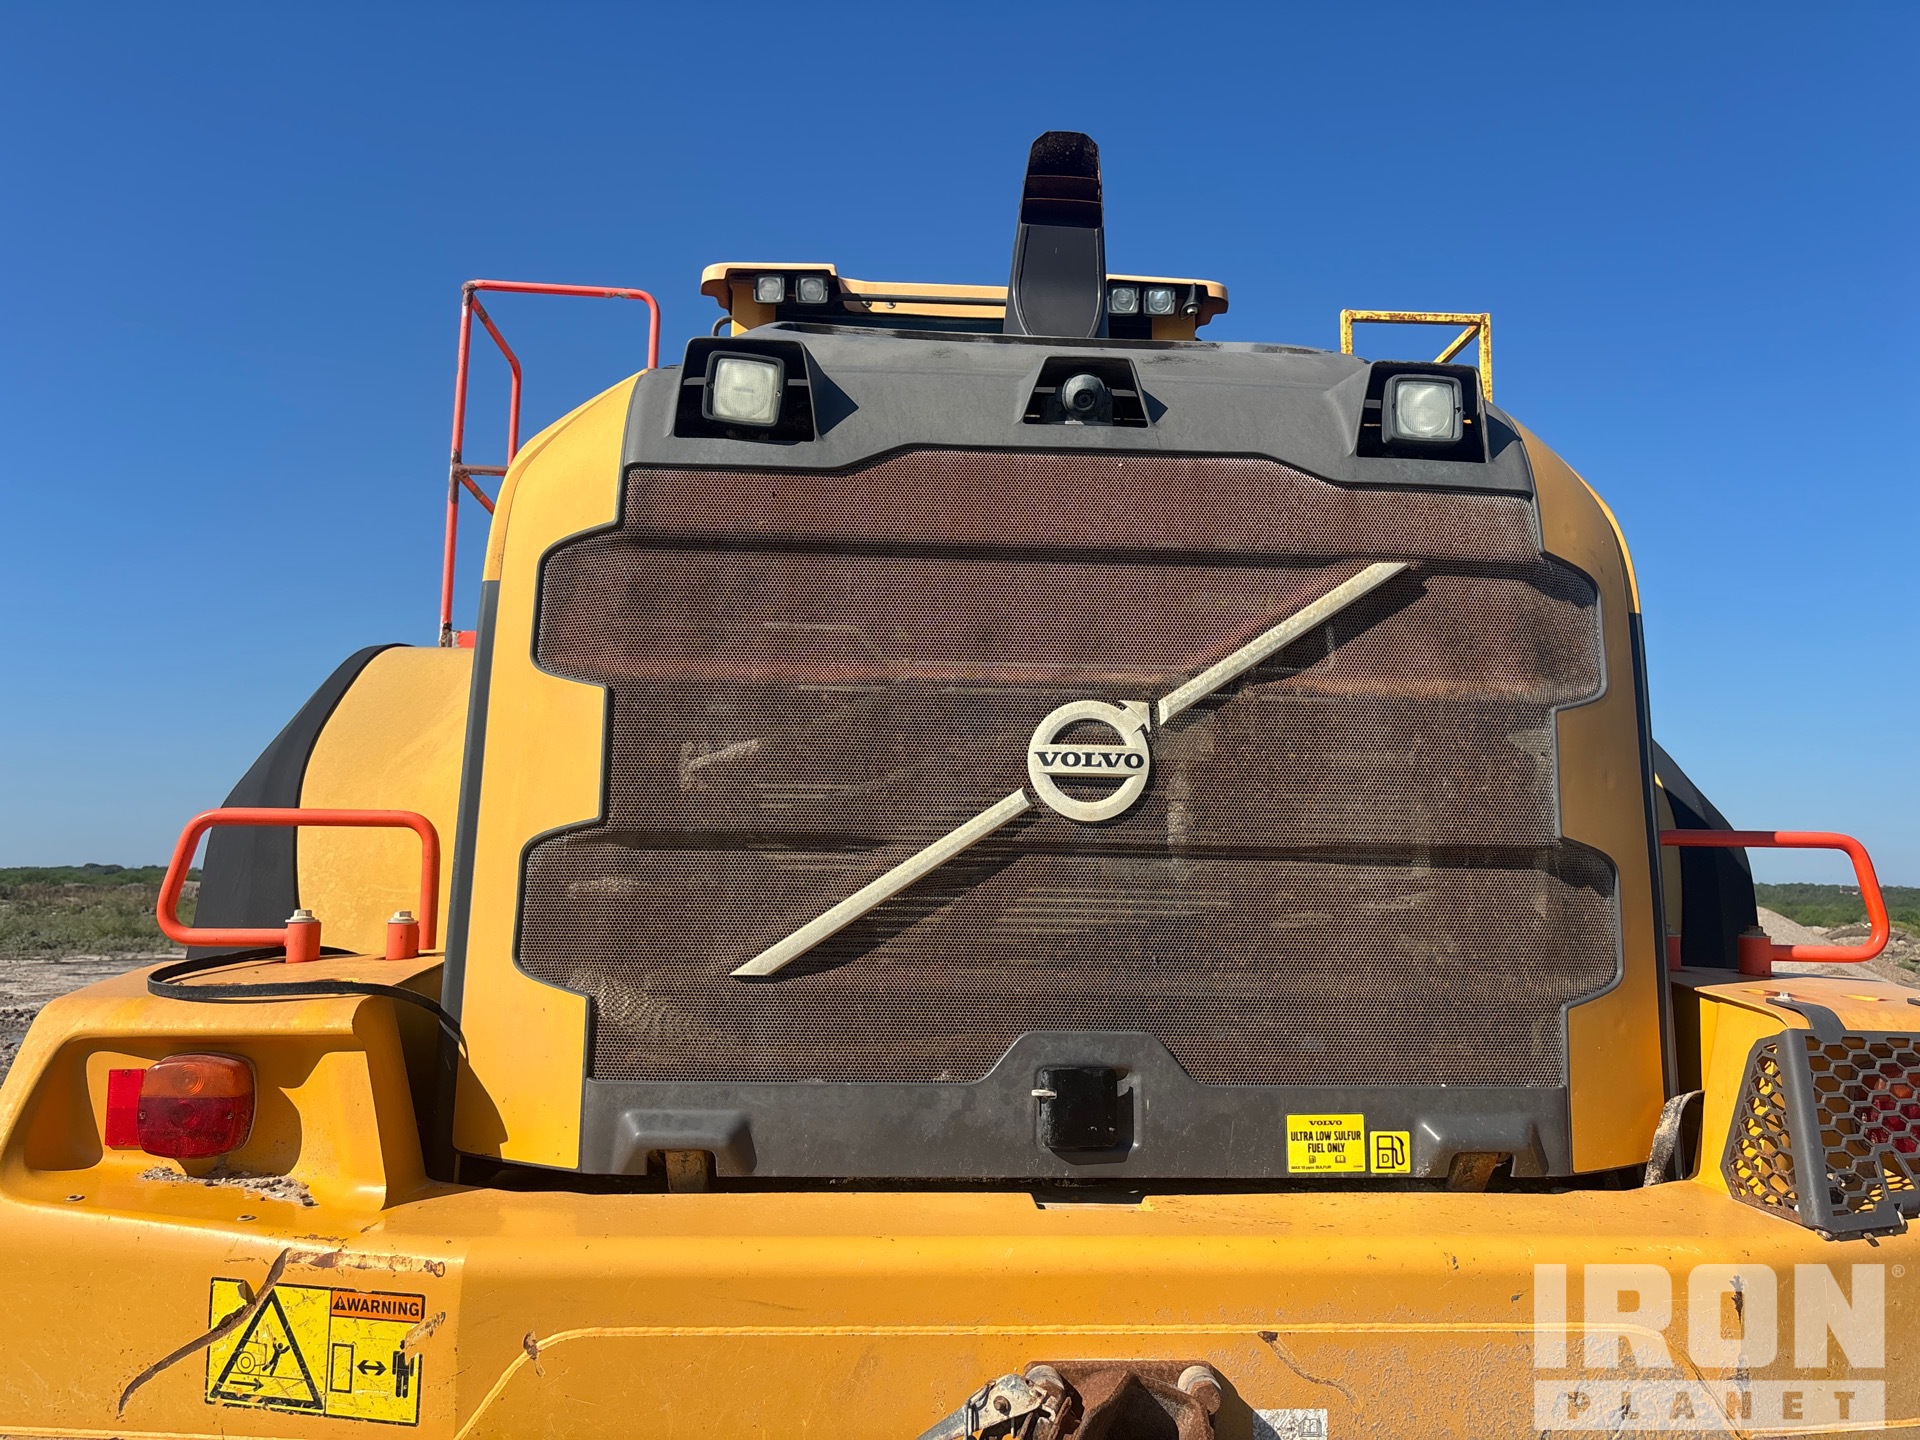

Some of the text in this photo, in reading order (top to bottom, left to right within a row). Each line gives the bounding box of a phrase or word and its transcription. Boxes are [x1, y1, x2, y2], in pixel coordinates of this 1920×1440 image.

[1034, 751, 1145, 769] VOLVO
[1290, 1130, 1361, 1141] ULTRA LOW SULFUR
[1308, 1143, 1345, 1153] FUEL ONLY
[346, 1297, 420, 1317] WARNING
